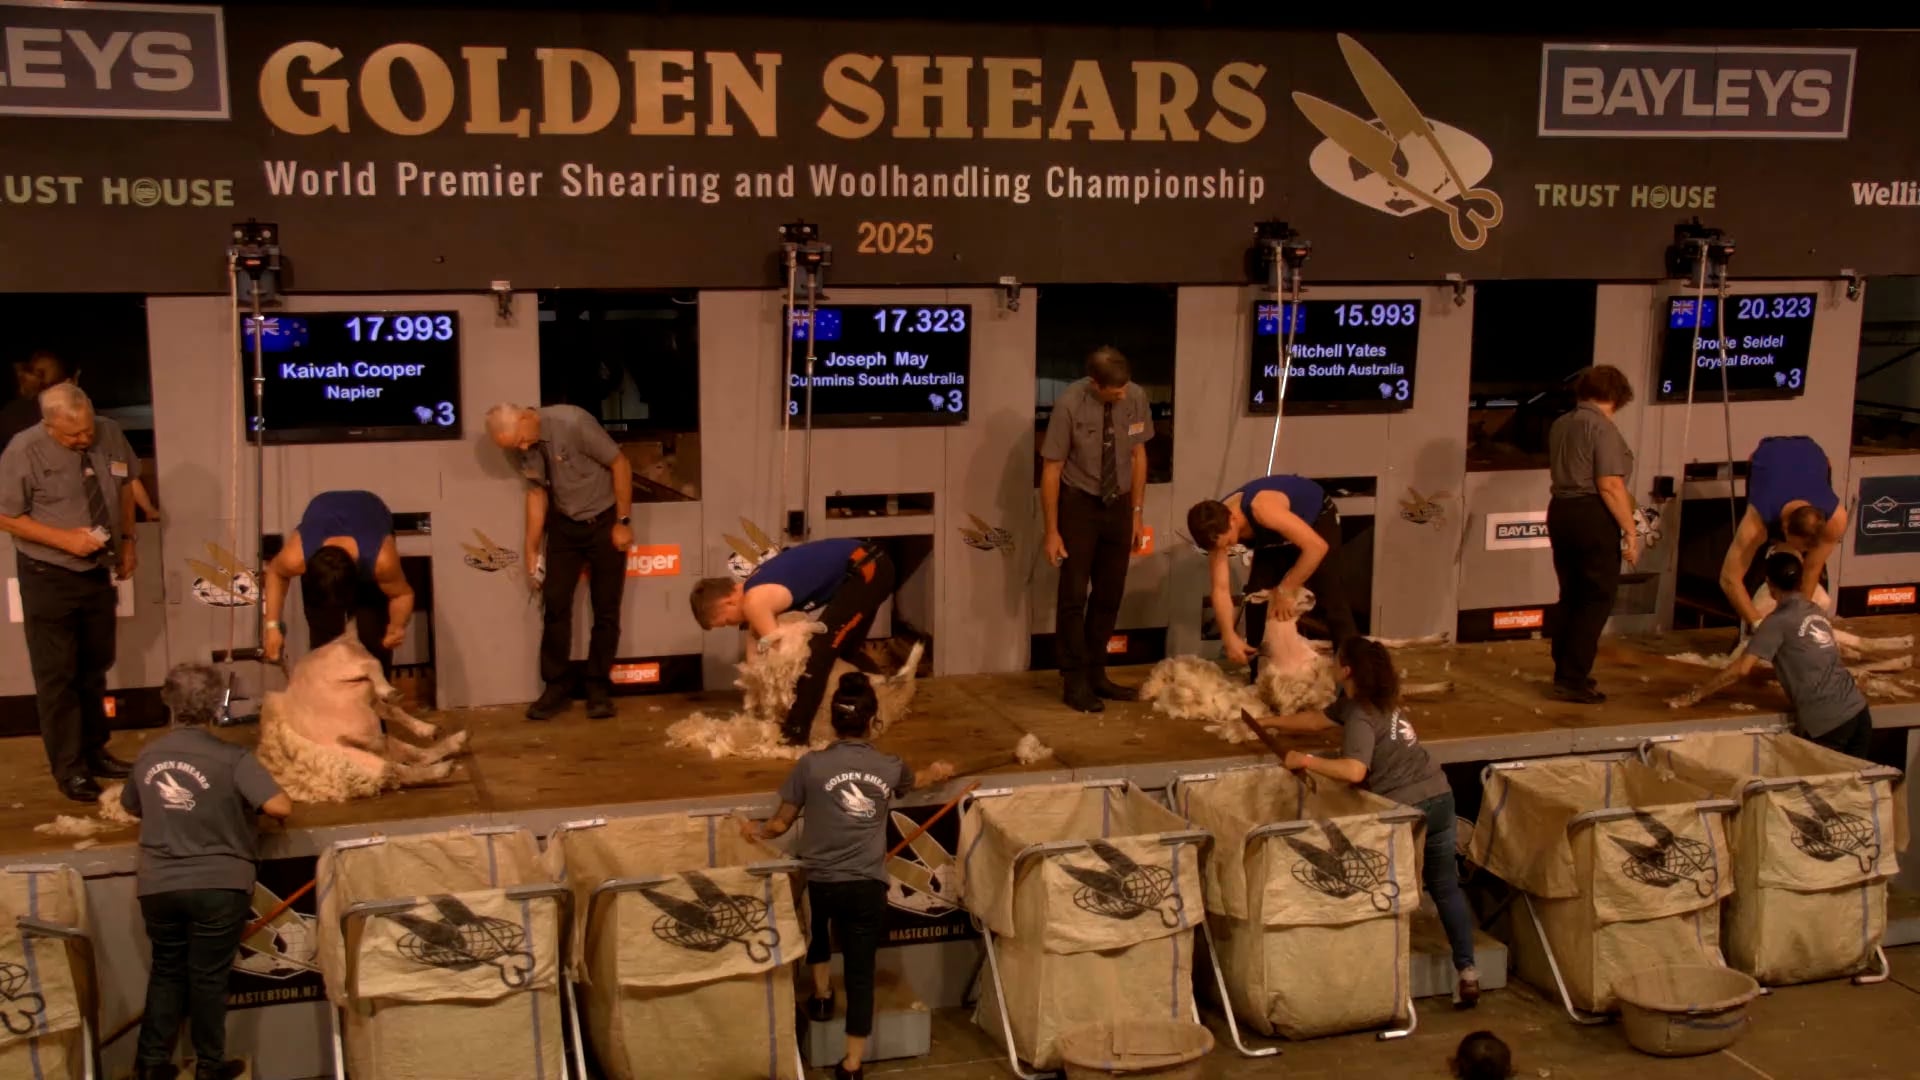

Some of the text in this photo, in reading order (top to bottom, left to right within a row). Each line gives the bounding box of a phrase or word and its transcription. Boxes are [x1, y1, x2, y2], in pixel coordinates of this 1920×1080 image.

[0, 27, 194, 91] EYS
[258, 41, 1268, 143] GOLDEN SHEARS
[1562, 66, 1833, 118] BAYLEYS
[0, 175, 235, 207] UST HOUSE
[263, 160, 1265, 204] World Premier Shearing and Woolhandling Championship
[1852, 181, 1920, 205] Welli
[1535, 183, 1716, 209] TRUST HOUSE
[858, 222, 934, 255] 2025
[1334, 304, 1415, 327] 15.993
[1737, 297, 1811, 320] 20.323
[346, 315, 453, 342] 17.993
[874, 309, 966, 333] 17.323
[1346, 344, 1386, 358] Yates
[1743, 335, 1784, 348] Seidel
[282, 362, 426, 380] Kaivah Cooper
[826, 351, 928, 370] Joseph May
[1308, 364, 1345, 377] South
[1348, 363, 1404, 376] Australia
[1740, 353, 1774, 366] Brook
[789, 371, 965, 388] Cummins South Australia
[1395, 379, 1409, 401] 3
[1662, 380, 1672, 393] 5
[1788, 368, 1801, 389] 3
[327, 385, 383, 401] Napier
[947, 389, 963, 412] 3
[1253, 390, 1264, 404] 4
[437, 402, 455, 426] 3
[788, 400, 798, 415] 3
